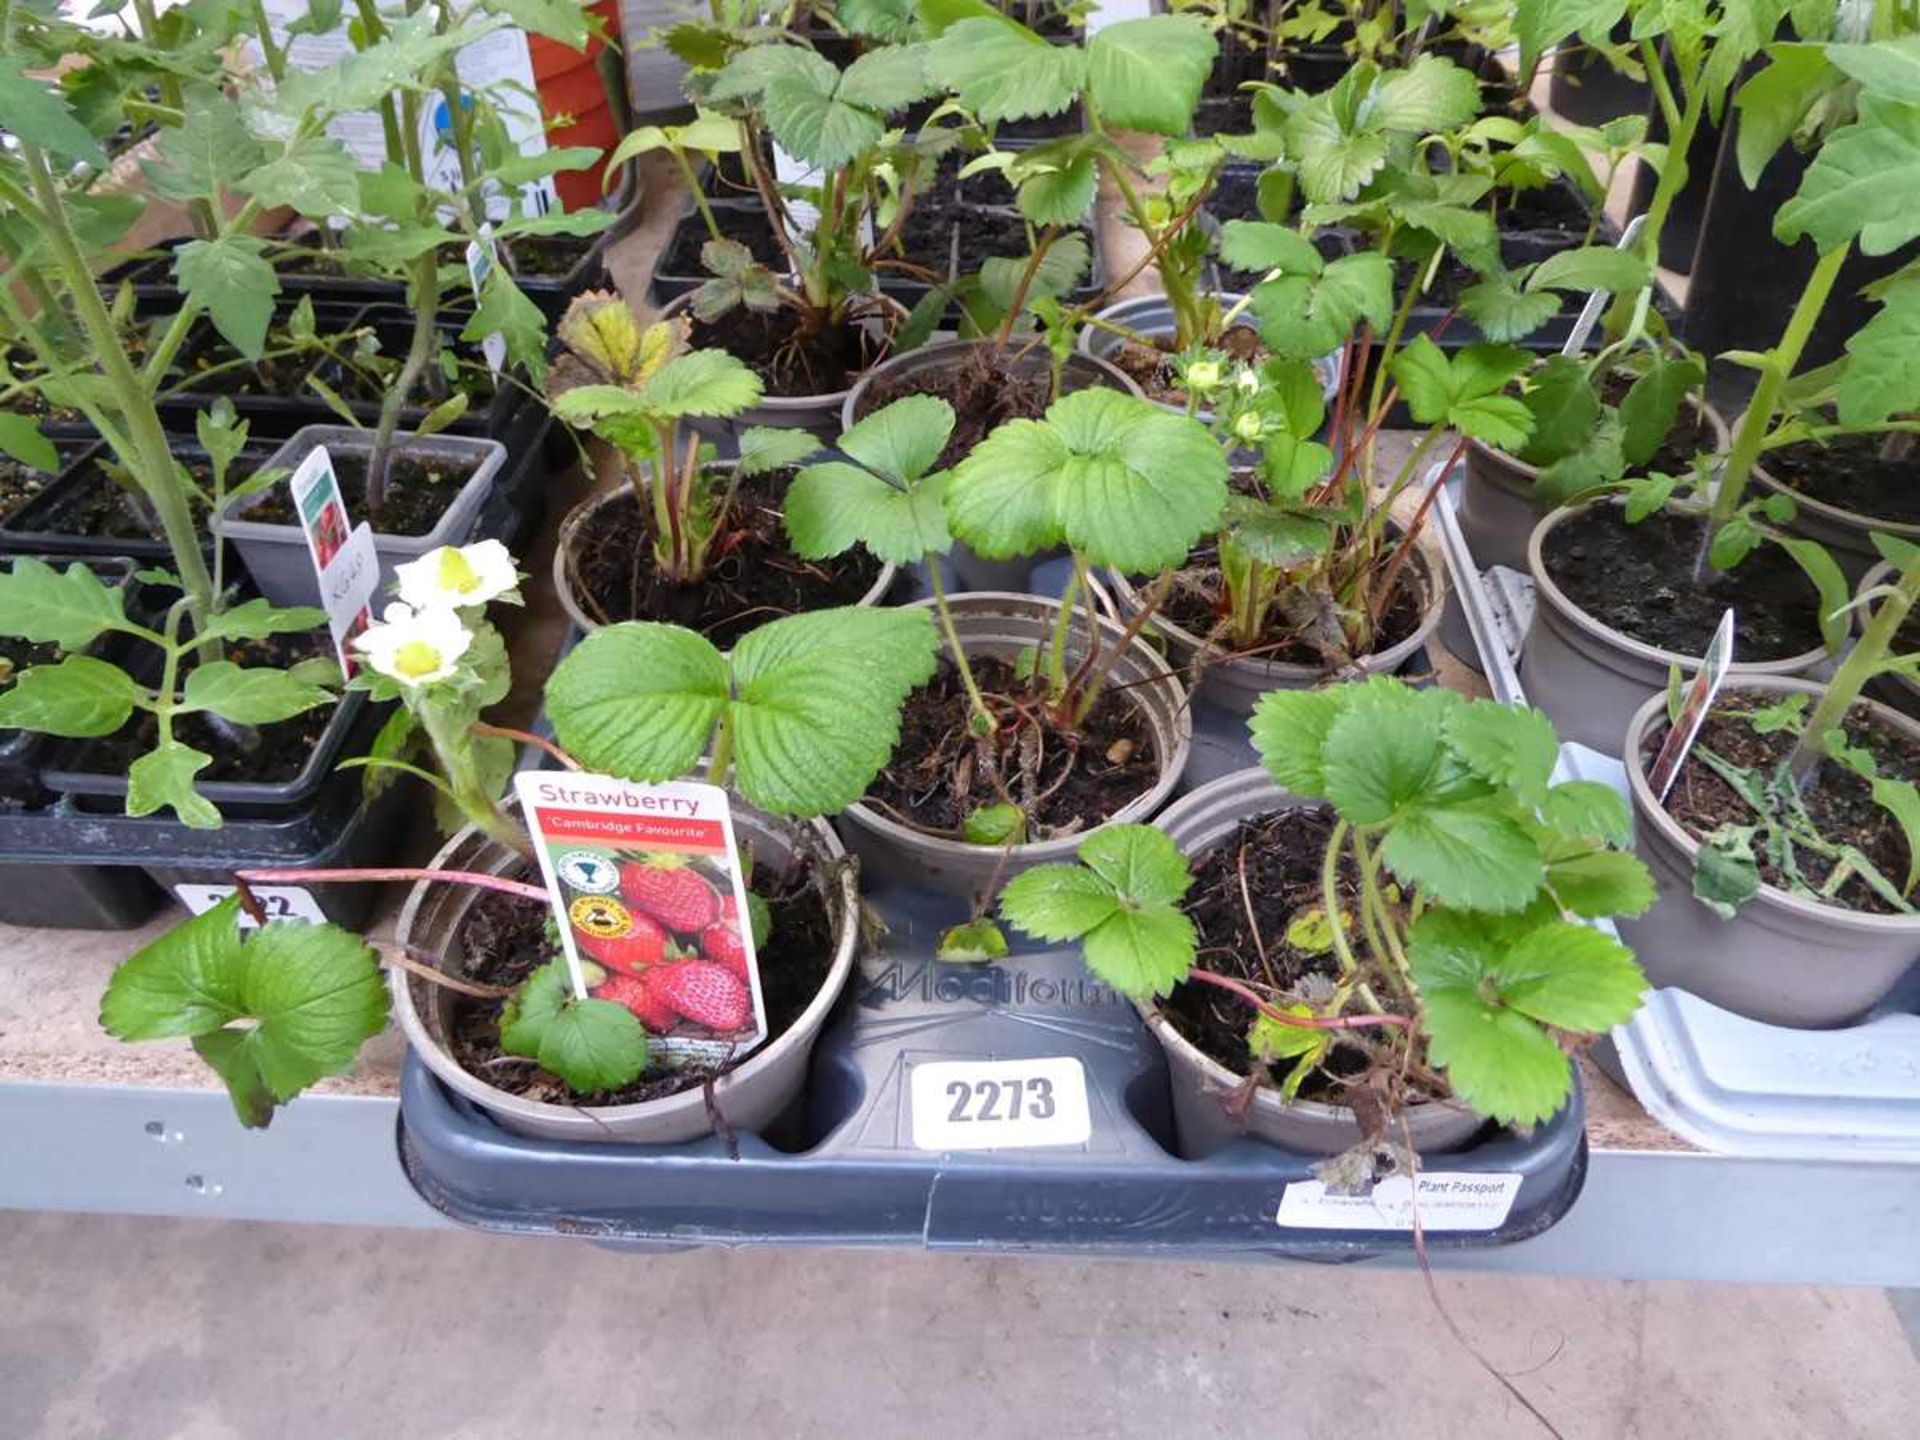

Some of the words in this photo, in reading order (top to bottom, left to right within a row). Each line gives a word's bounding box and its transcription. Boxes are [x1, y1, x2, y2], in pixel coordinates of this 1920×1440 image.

[538, 783, 700, 816] Strawberry
[946, 1076, 1055, 1122] 2273
[1418, 1180, 1449, 1193] Plant
[1451, 1181, 1505, 1195] Passport
